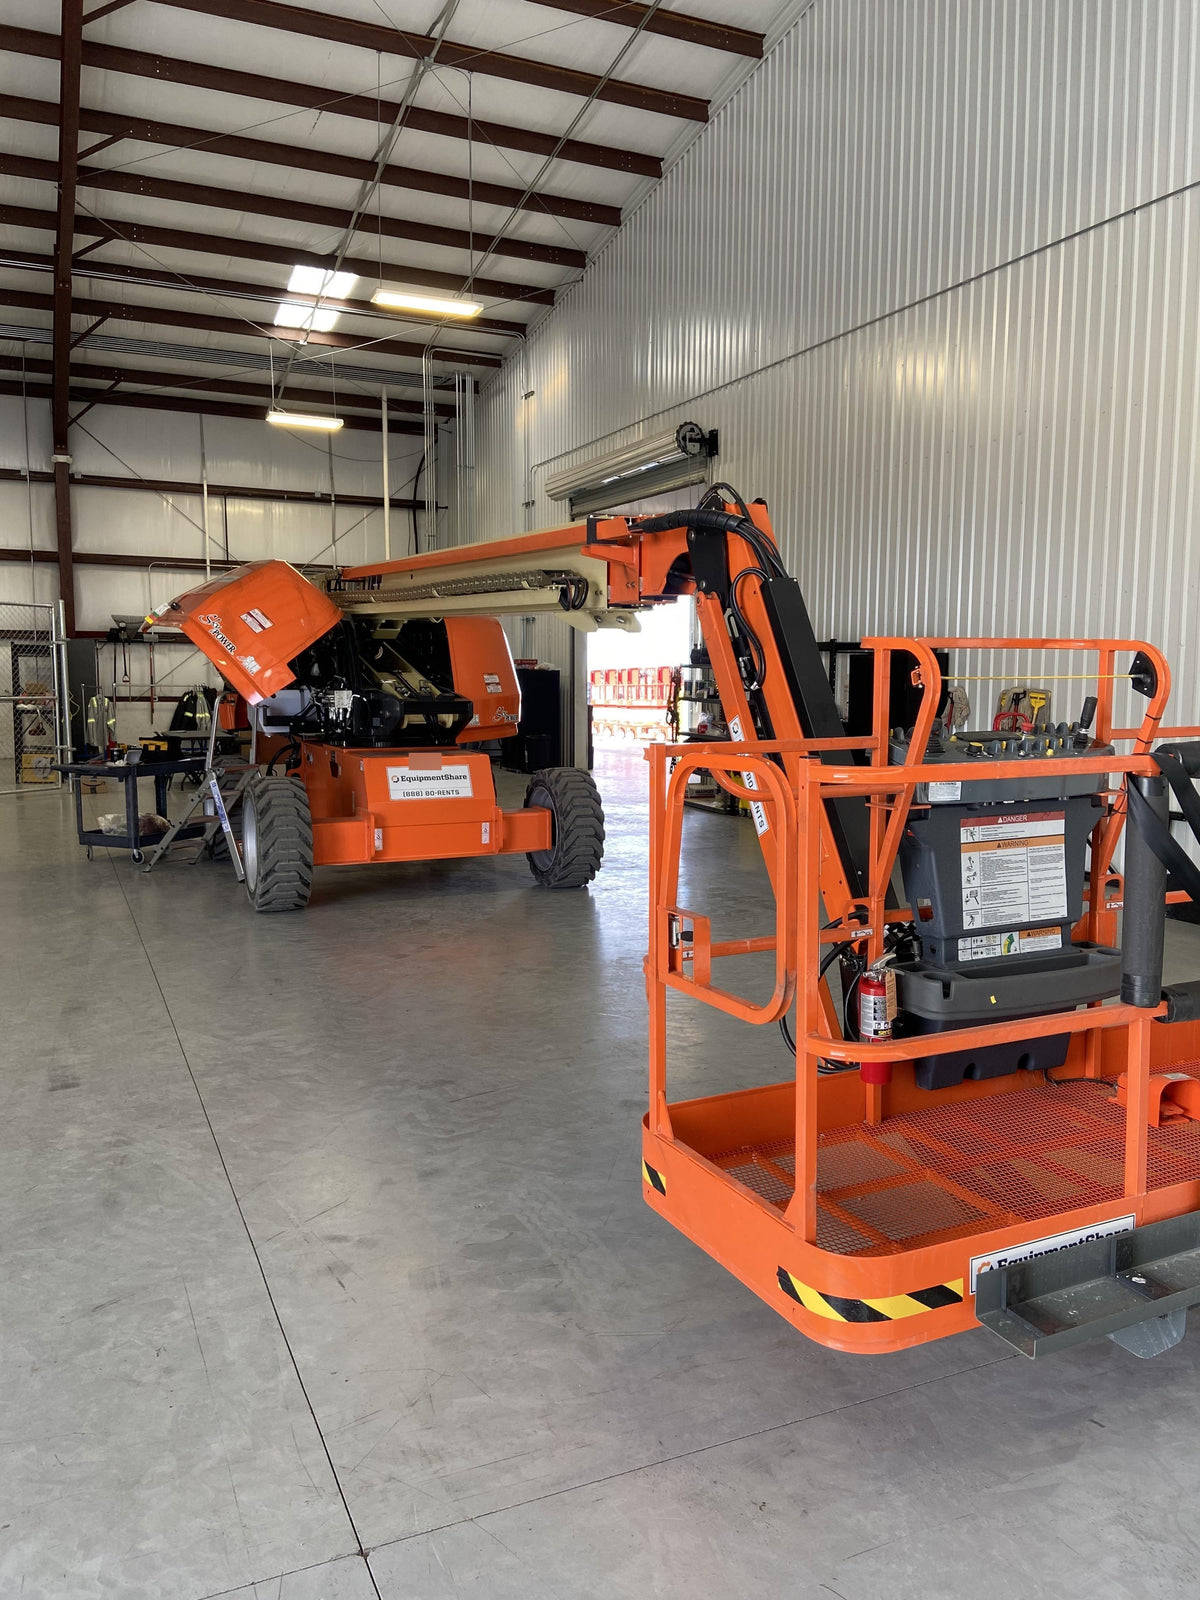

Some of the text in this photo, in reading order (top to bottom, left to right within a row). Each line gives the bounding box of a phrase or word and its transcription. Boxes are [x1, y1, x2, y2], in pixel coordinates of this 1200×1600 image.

[212, 629, 236, 655] POWER
[400, 774, 468, 783] EquipmentShare
[425, 789, 460, 797] 80-RENTS
[1002, 814, 1028, 823] DANGER
[1001, 839, 1029, 848] WARNING
[1031, 928, 1056, 937] WARNING
